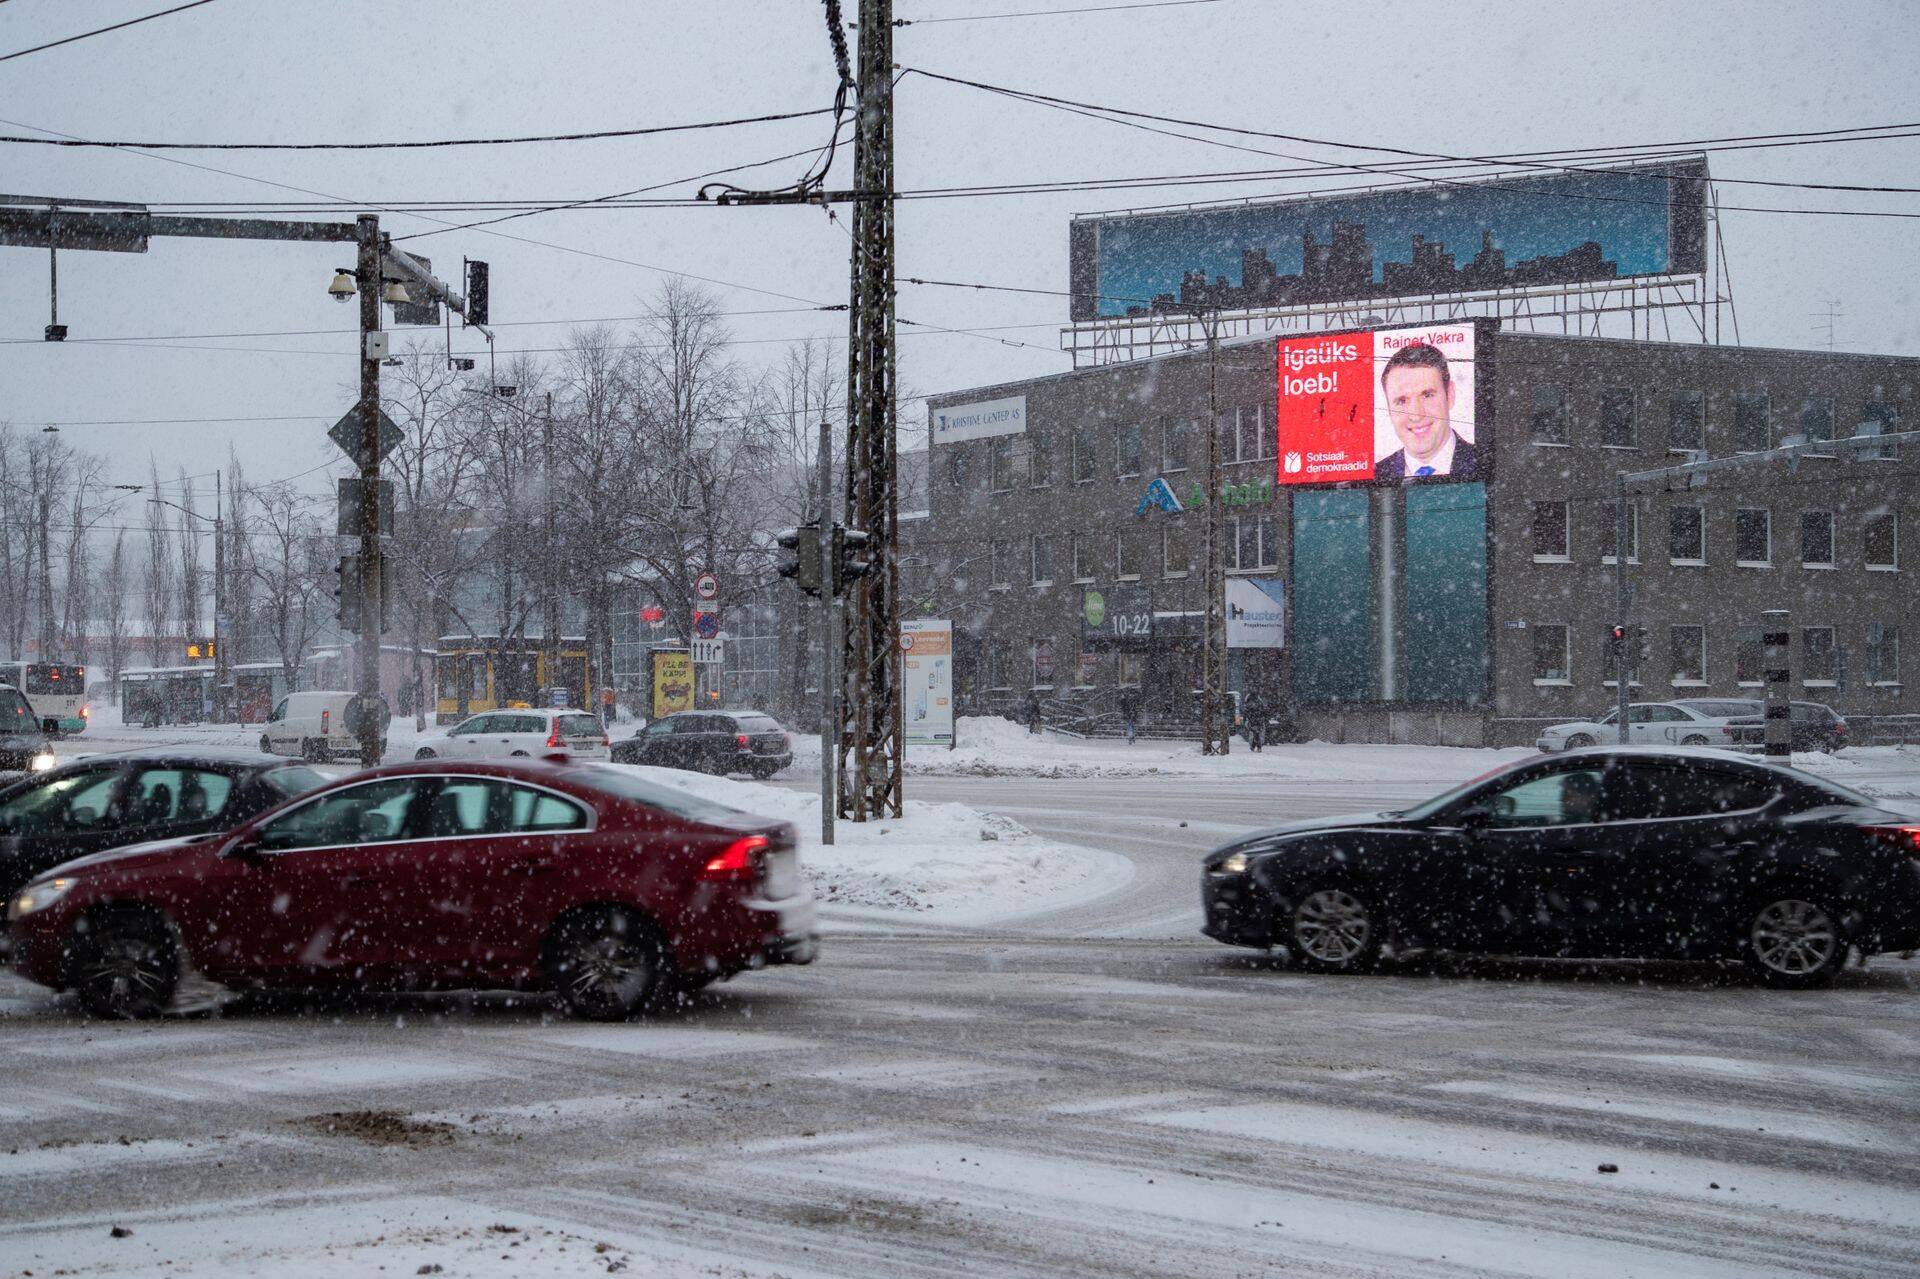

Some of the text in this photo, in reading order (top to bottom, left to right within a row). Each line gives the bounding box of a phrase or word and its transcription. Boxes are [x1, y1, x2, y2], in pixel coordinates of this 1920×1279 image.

[1384, 332, 1464, 349] Rainer Vakra
[1284, 341, 1357, 371] Igaüks
[1284, 371, 1338, 396] loeb!
[1306, 452, 1348, 462] Sotsiaal-
[1306, 461, 1368, 473] demokraadid
[1113, 615, 1149, 635] 10-22
